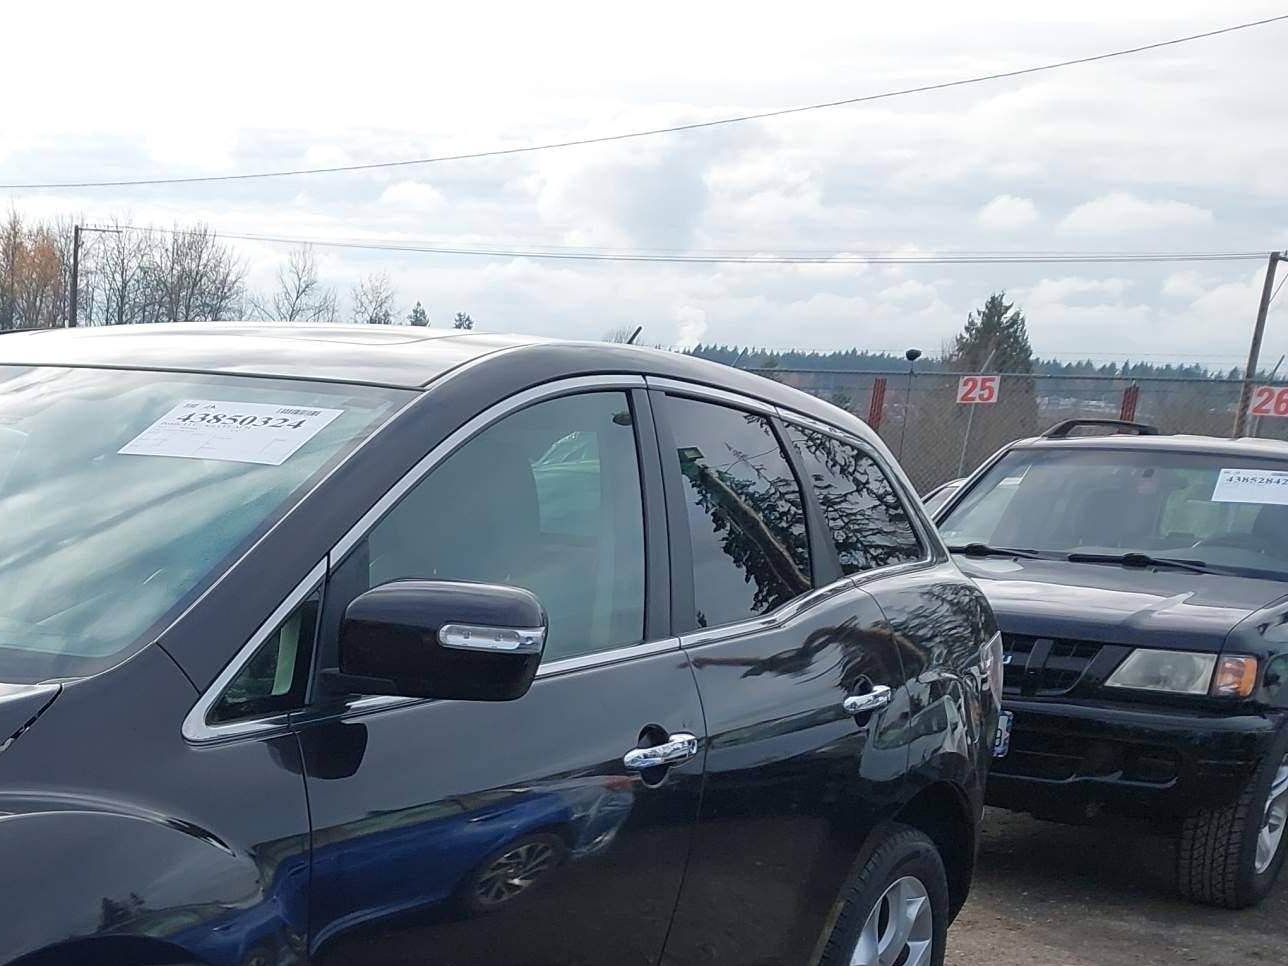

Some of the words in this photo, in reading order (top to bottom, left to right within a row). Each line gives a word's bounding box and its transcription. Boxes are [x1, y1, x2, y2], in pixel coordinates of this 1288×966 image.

[959, 377, 996, 402] 25
[1252, 387, 1288, 416] 26
[176, 412, 307, 430] 43850324
